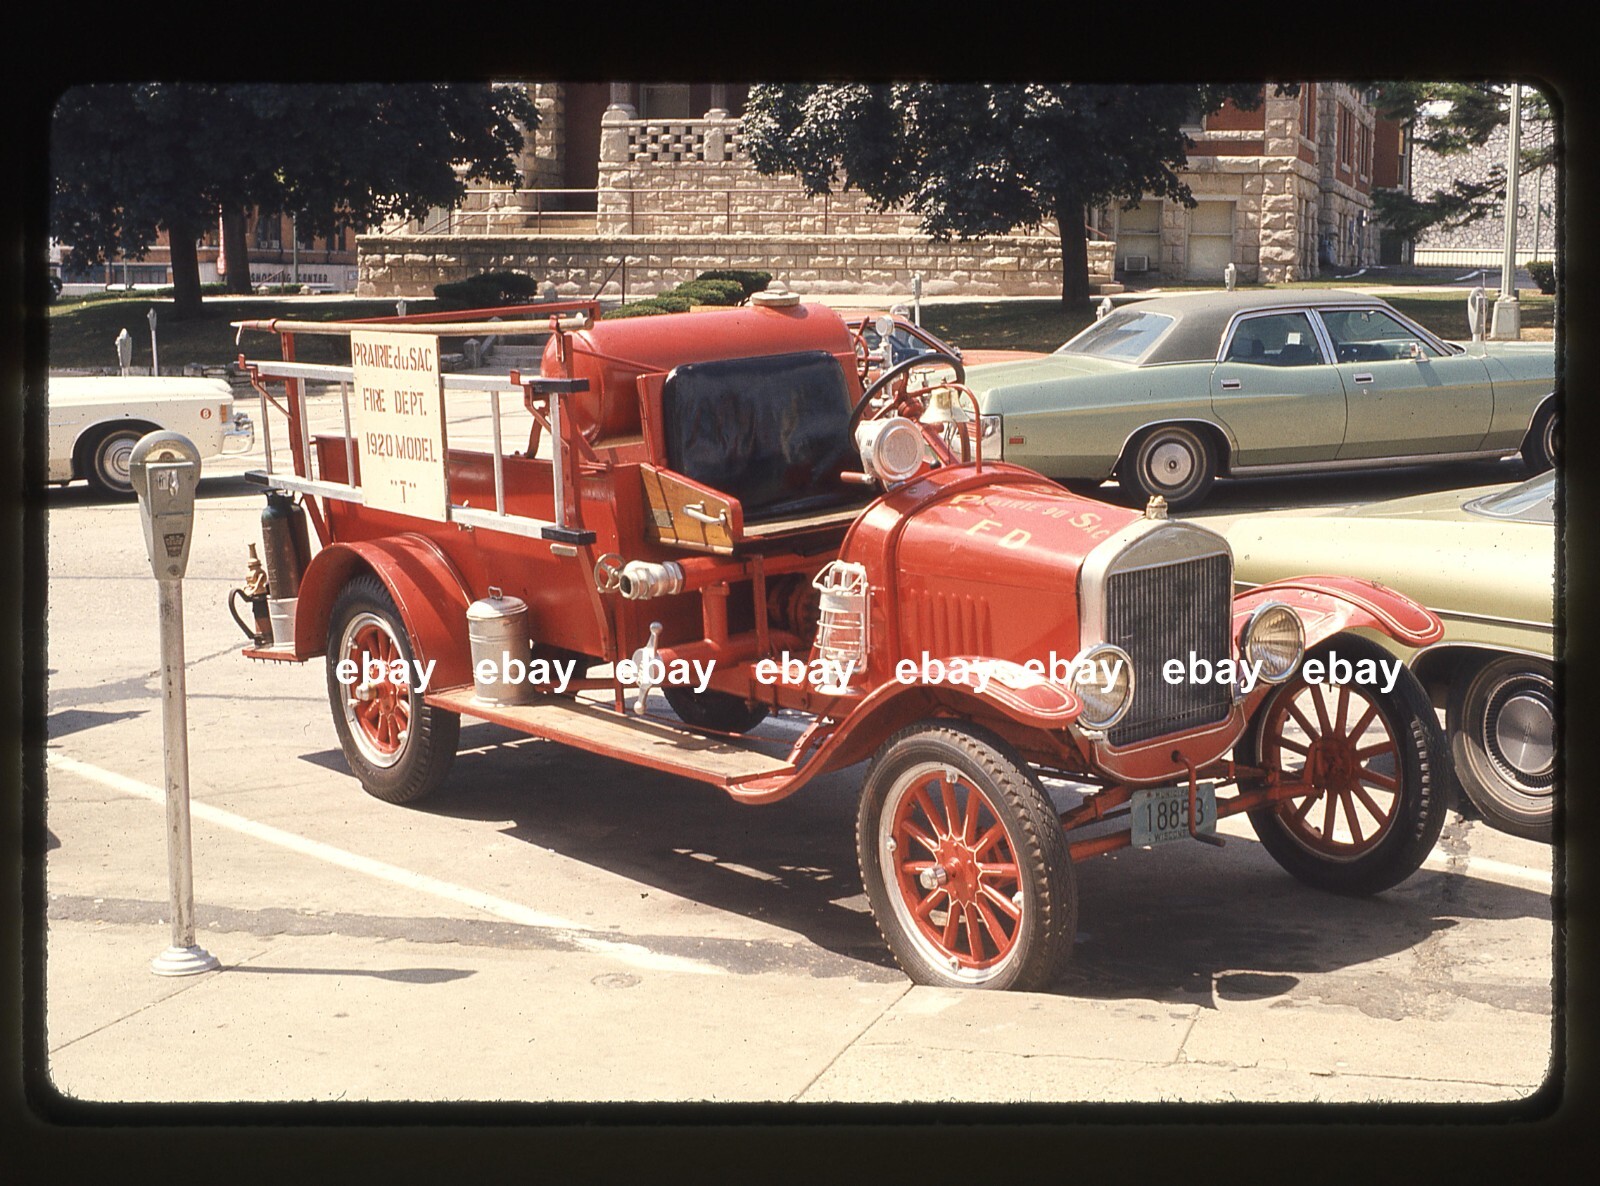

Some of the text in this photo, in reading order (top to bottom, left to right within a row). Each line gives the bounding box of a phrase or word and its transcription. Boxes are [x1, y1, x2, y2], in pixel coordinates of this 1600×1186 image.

[353, 342, 433, 372] PRAIRIE du SAC
[362, 387, 427, 416] FIRE DEPT.
[366, 431, 437, 463] 1920 MODEL
